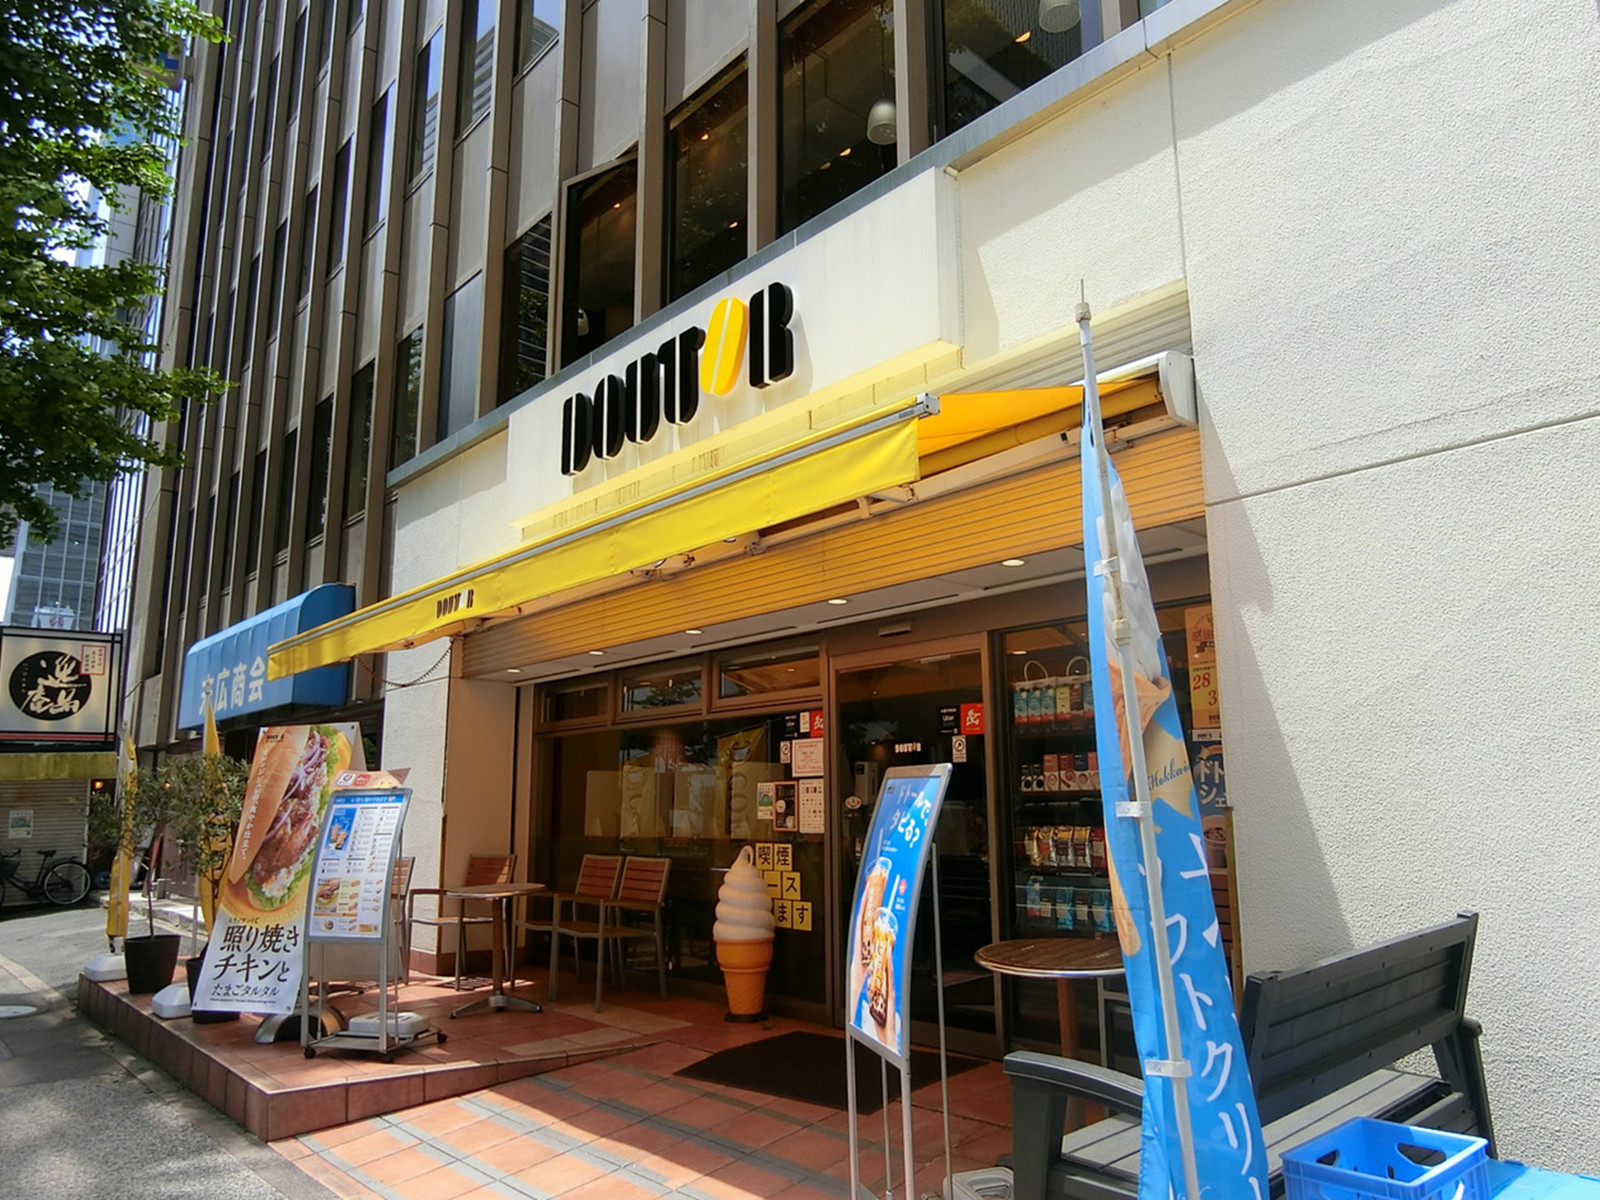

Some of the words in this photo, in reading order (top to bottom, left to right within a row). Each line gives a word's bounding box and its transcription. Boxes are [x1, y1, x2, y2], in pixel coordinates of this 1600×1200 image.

[561, 281, 795, 476] DOUTOR
[436, 588, 475, 619] DOUTOR
[1192, 672, 1211, 690] 28
[758, 845, 790, 866] 喫煙
[219, 923, 299, 953] 照り焼き
[212, 953, 290, 983] チキンと
[210, 983, 281, 997] たまごタルタル
